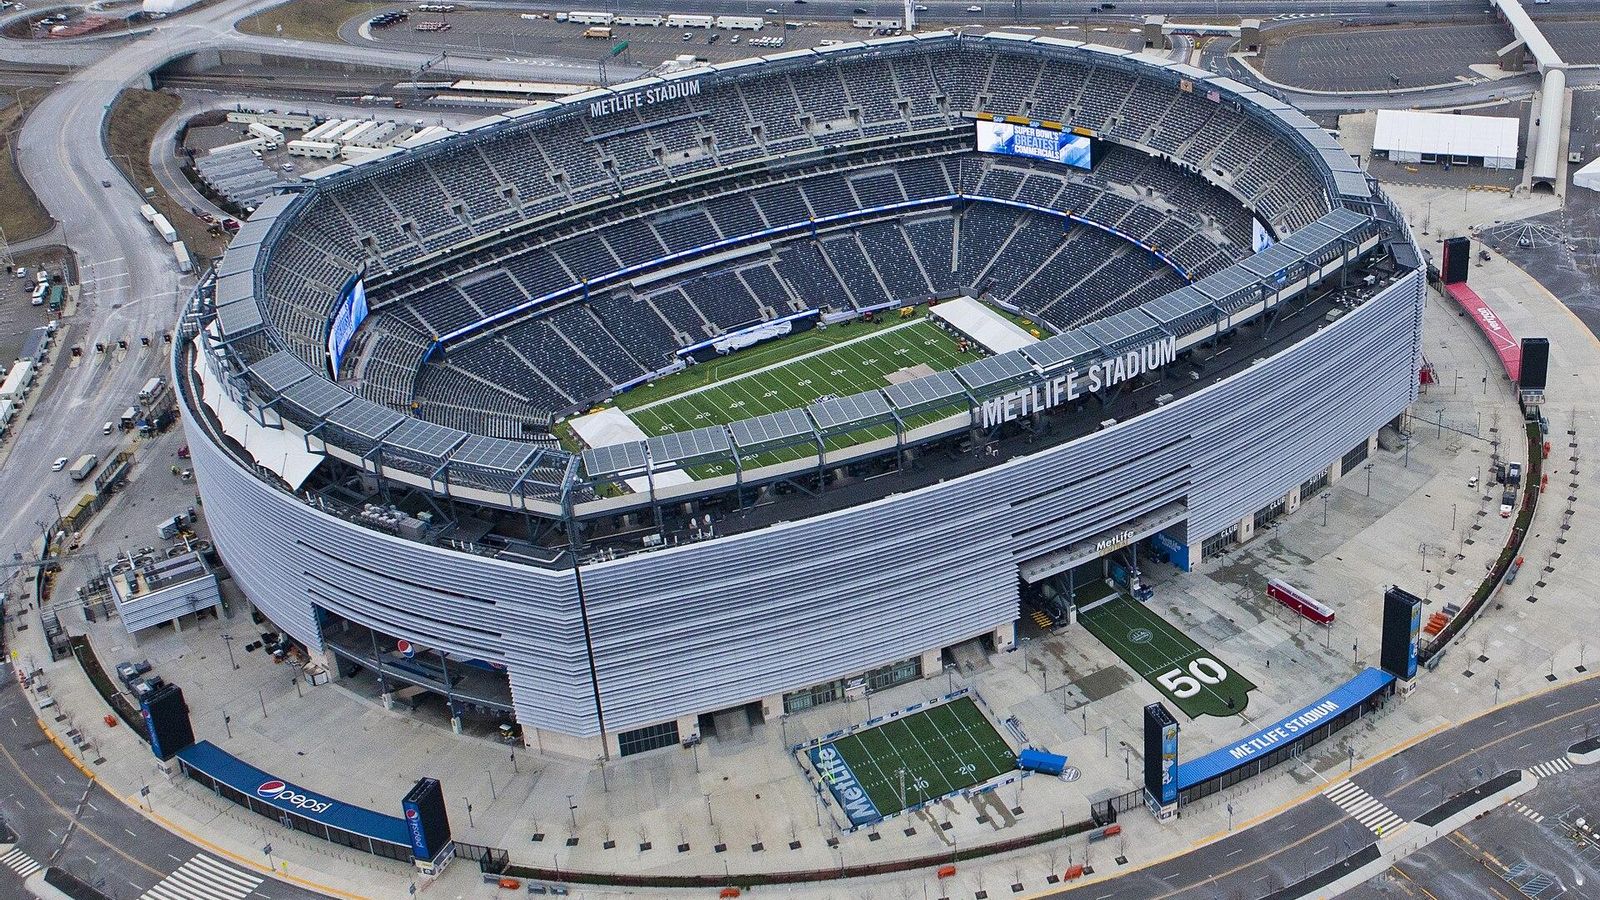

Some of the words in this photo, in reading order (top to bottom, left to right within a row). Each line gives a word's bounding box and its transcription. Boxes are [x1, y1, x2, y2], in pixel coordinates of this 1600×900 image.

[590, 91, 643, 117] METLIFE
[646, 80, 701, 104] STADIUM
[1014, 125, 1035, 137] SUPER
[1036, 128, 1059, 141] BOWL'S
[1014, 134, 1059, 151] GREATEST
[1014, 145, 1061, 159] COMMERCIALS
[982, 371, 1081, 429] METLIFE
[1088, 335, 1177, 393] STADIUM
[1269, 496, 1286, 510] CLUB
[1096, 530, 1135, 552] MetLife
[1220, 522, 1238, 538] CLUB
[1156, 657, 1228, 699] 50
[1229, 724, 1290, 760] METLIFE
[1284, 699, 1339, 739] STADIUM
[958, 763, 976, 775] 20
[816, 747, 876, 818] MetLife
[274, 790, 333, 814] pepsi
[410, 822, 424, 848] pepsi
